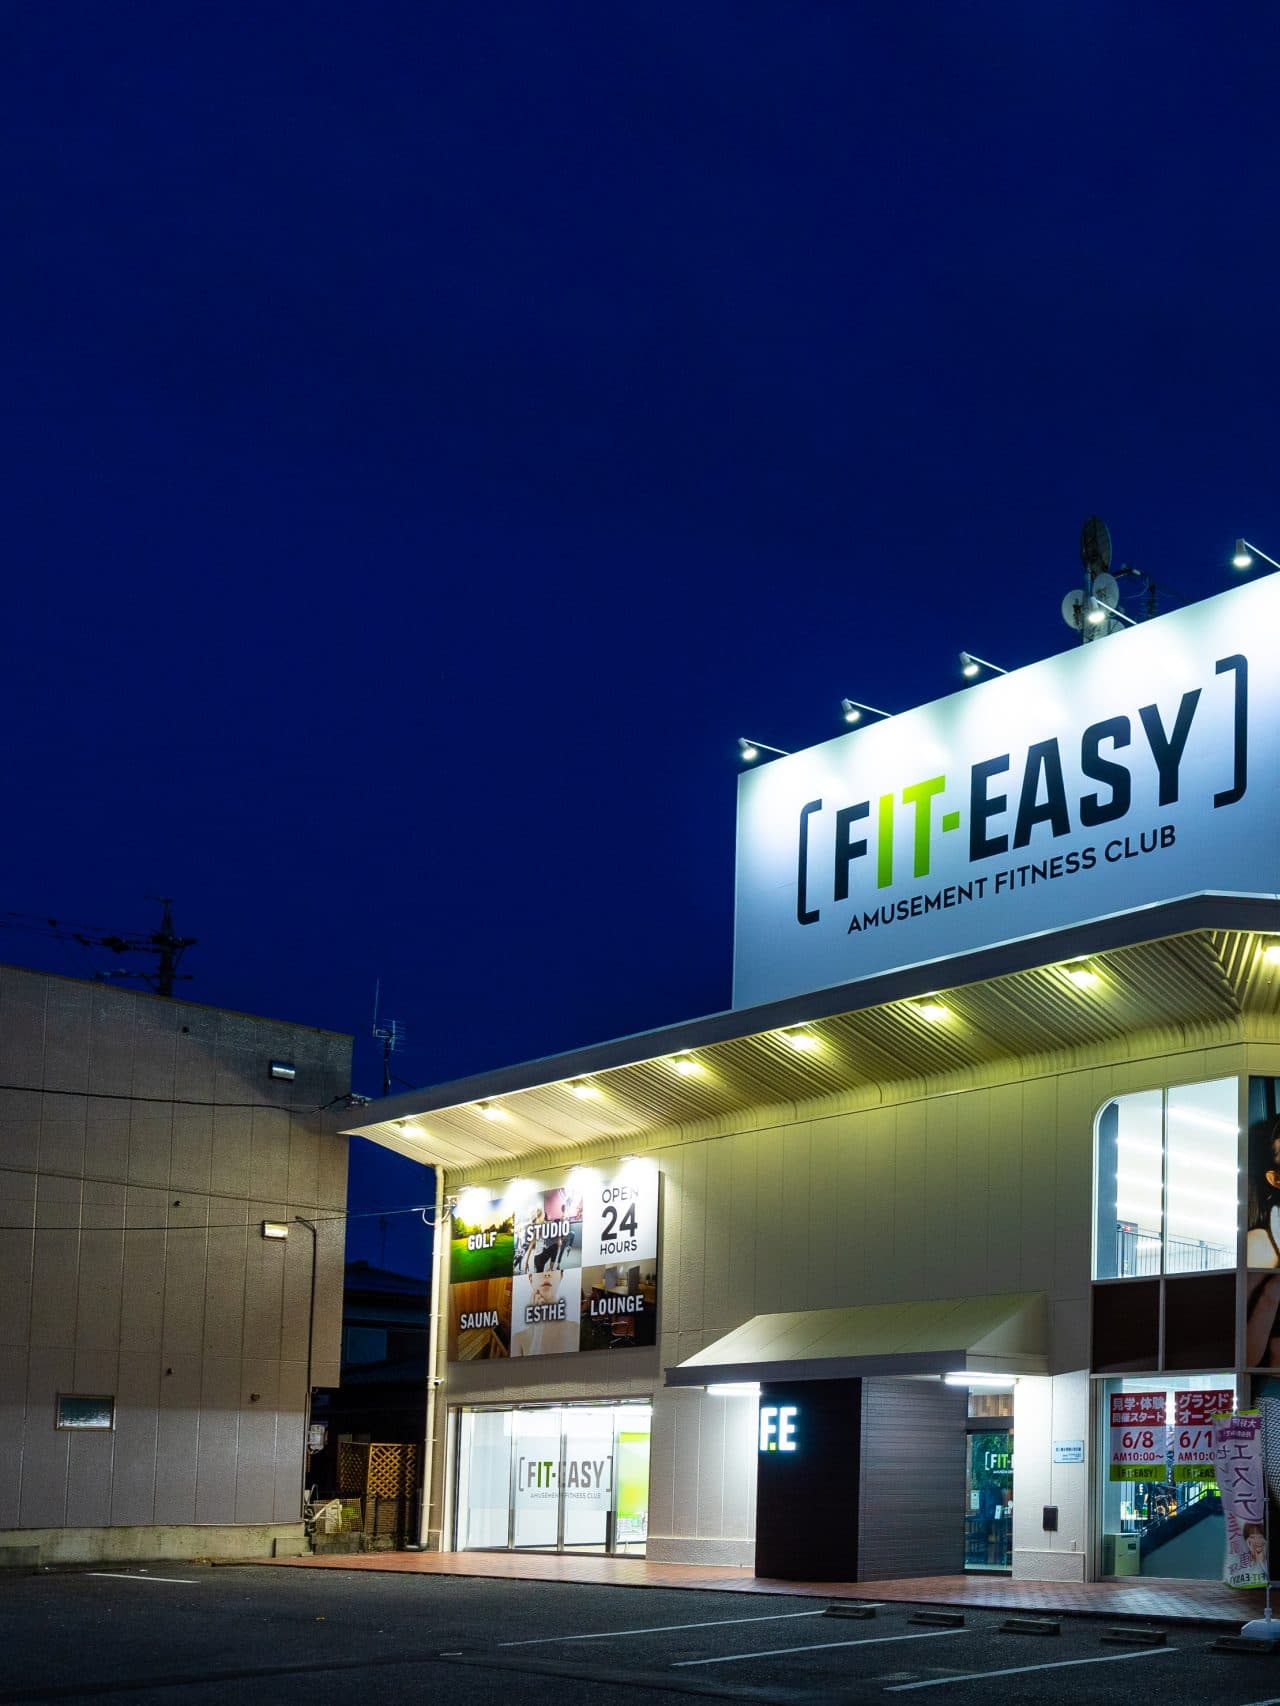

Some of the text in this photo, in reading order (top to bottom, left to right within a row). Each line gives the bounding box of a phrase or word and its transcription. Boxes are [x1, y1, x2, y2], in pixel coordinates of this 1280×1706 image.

[847, 825, 1176, 934] AMUSEMENT FITNESS CLUB
[602, 1186, 639, 1203] OPEN
[527, 1221, 570, 1242] STUDIO
[601, 1203, 638, 1241] 24
[467, 1231, 497, 1250] GOLF
[600, 1240, 638, 1255] HOURS
[525, 1299, 565, 1323] ESTHÉ
[590, 1295, 644, 1316] LOUNGE
[460, 1311, 499, 1329] SAUNA
[1179, 1393, 1230, 1408] グランド
[1122, 1430, 1153, 1449] 6/8
[1179, 1430, 1213, 1449] 6/1
